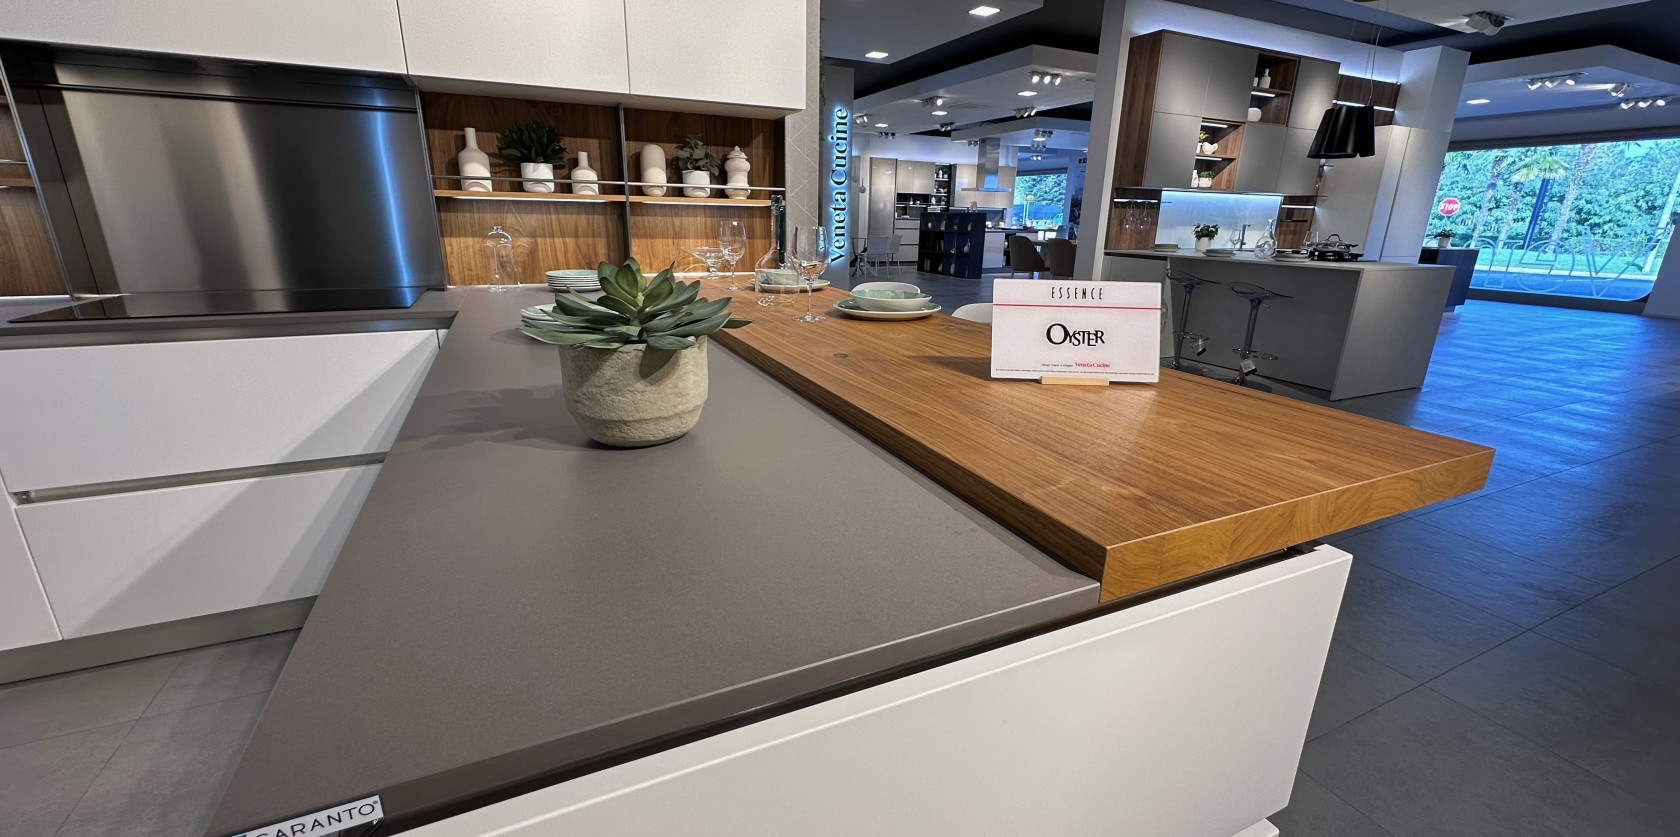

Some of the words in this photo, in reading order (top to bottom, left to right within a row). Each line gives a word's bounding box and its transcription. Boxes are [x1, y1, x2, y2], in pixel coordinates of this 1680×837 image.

[830, 107, 849, 186] Cucine
[1439, 203, 1459, 211] STOP
[830, 191, 847, 264] Veneta
[1051, 286, 1103, 300] ESSENCE
[1045, 323, 1106, 347] OYSTER
